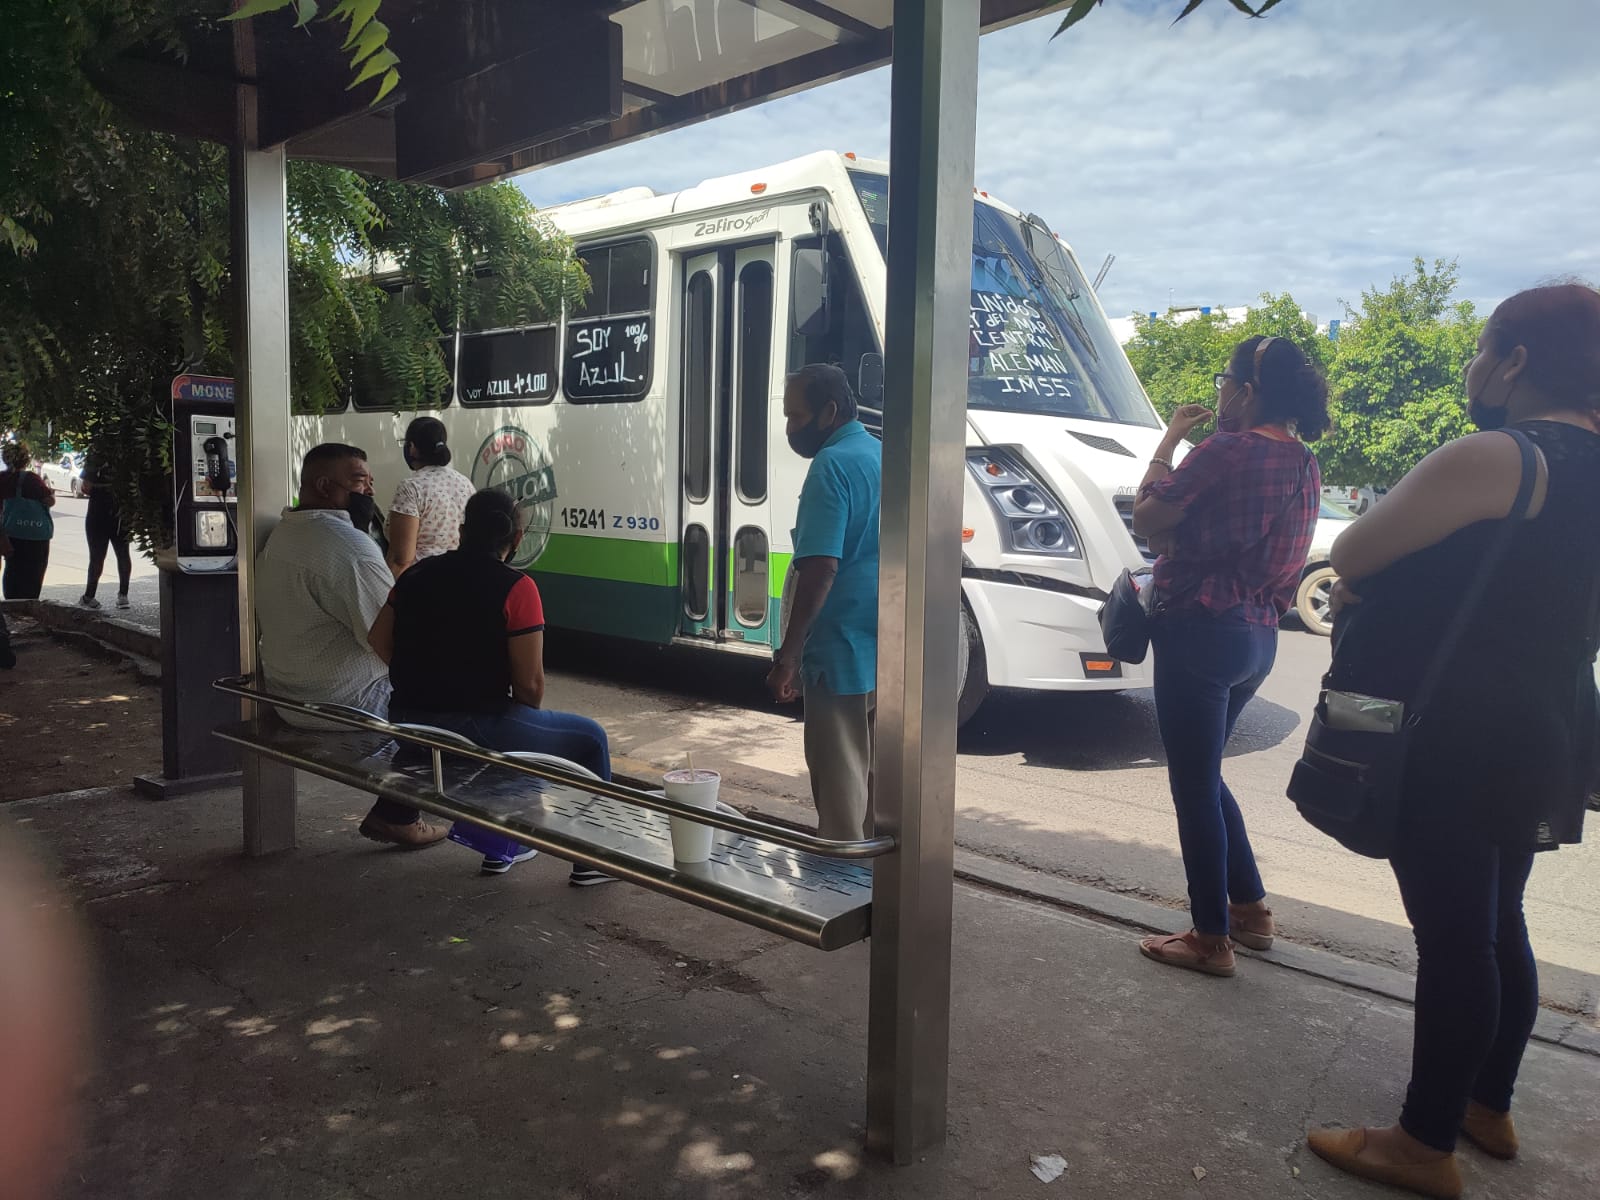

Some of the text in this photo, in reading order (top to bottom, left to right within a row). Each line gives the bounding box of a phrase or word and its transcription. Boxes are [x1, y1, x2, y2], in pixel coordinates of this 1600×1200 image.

[694, 217, 744, 237] Zafiro
[1013, 315, 1055, 339] MAR
[572, 326, 611, 358] SOY
[972, 330, 1062, 352] CENTRAL
[989, 351, 1069, 375] ALEMAN
[191, 384, 234, 400] MONE
[996, 375, 1072, 398] IMSS
[561, 507, 660, 531] 15241 Z 930
